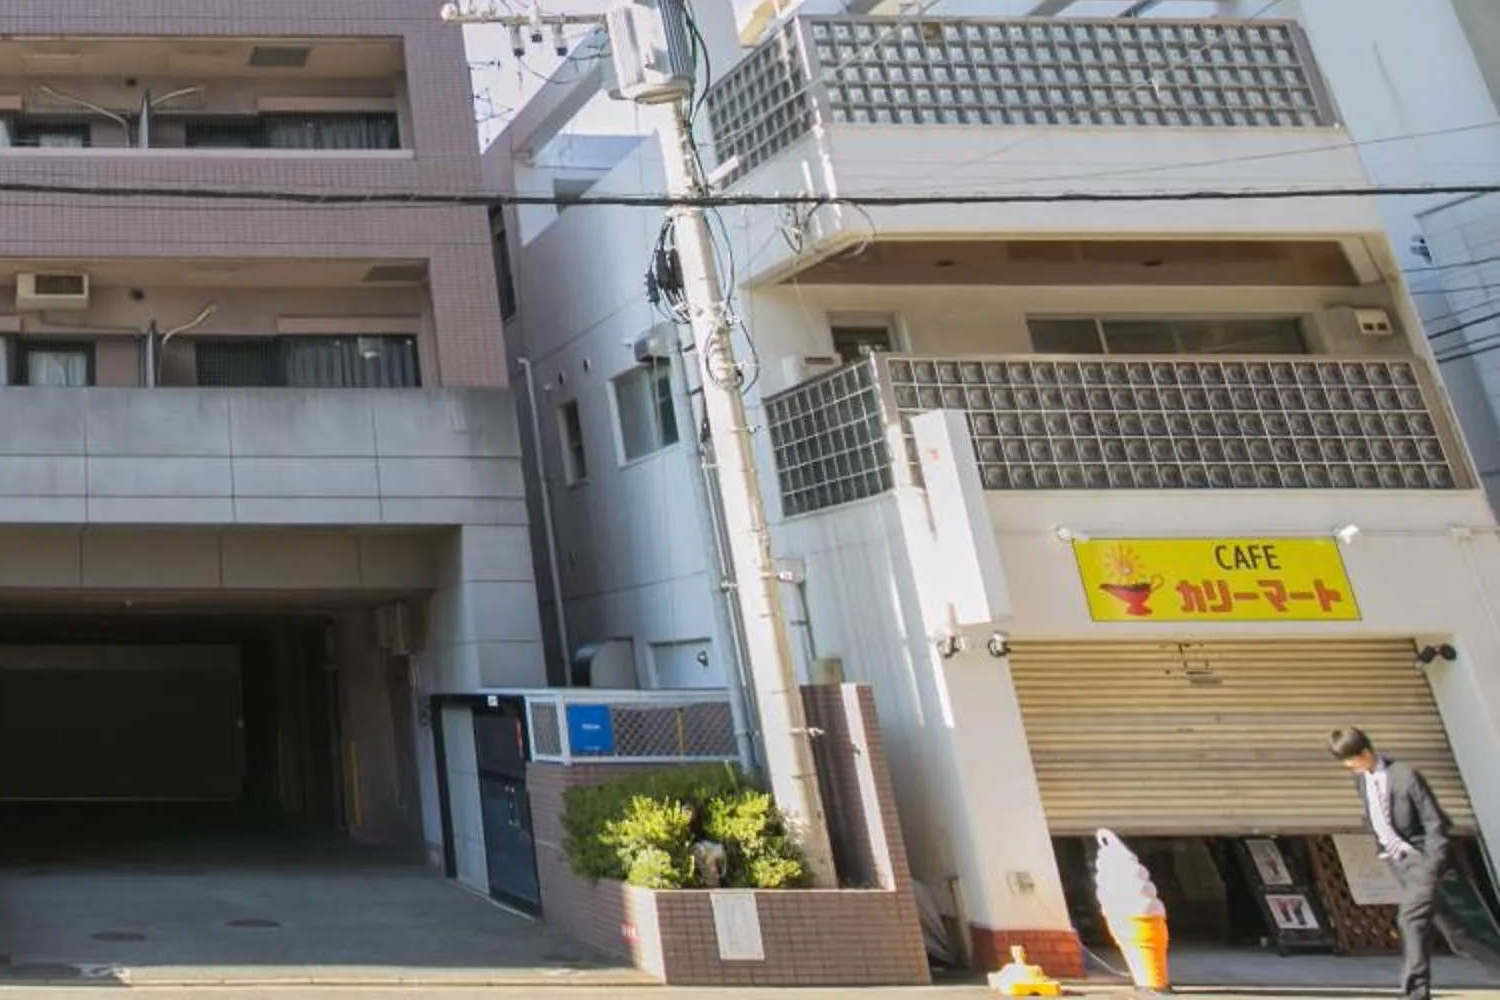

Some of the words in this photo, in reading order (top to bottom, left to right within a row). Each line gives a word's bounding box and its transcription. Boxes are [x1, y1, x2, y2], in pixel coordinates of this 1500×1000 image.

[1214, 545, 1281, 570] CAFE
[1175, 579, 1342, 613] カリーマート
